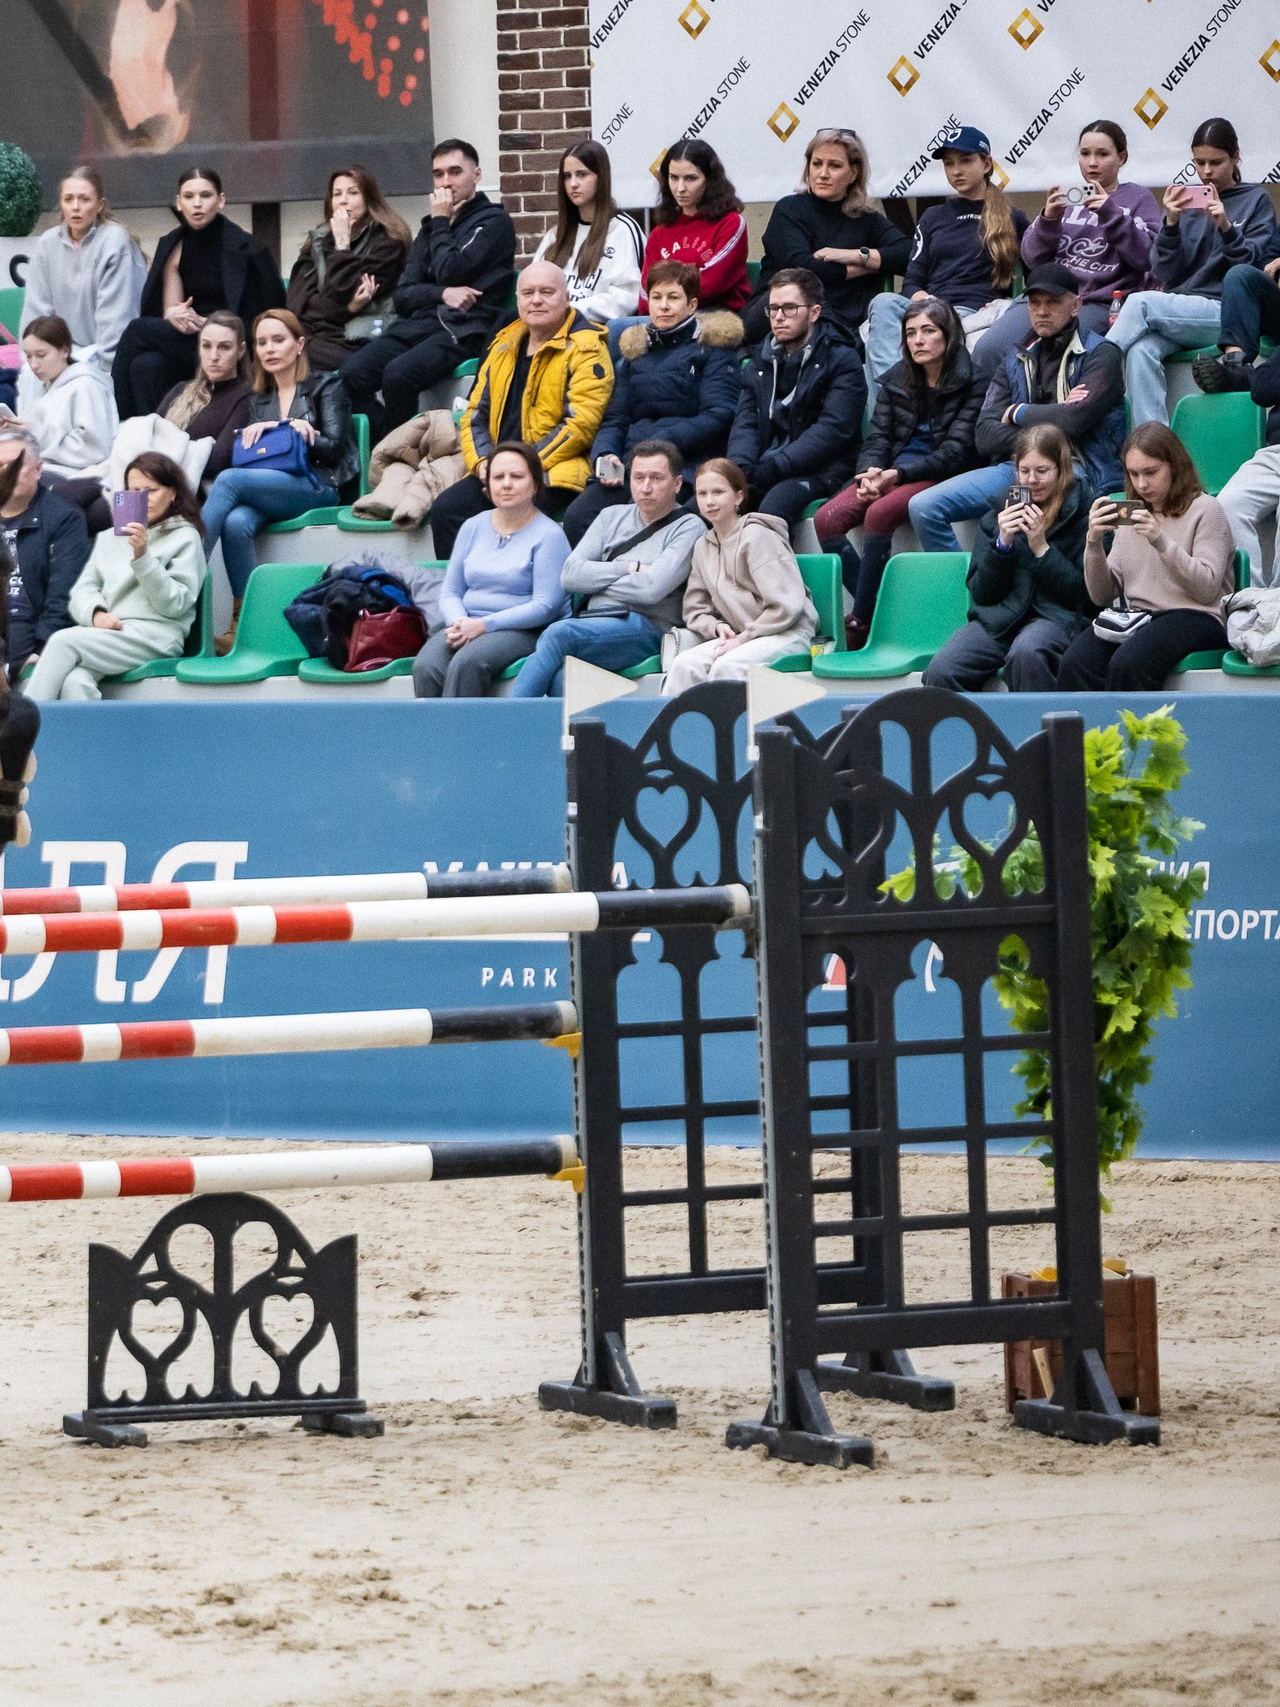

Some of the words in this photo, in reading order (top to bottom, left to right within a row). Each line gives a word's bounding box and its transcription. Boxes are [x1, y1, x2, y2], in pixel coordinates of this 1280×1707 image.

[793, 49, 840, 106] VENEZIA
[835, 9, 870, 53] STONE
[914, 2, 961, 60] VENEZIA
[1161, 34, 1211, 92] VENEZIA
[601, 102, 634, 145] STONE
[681, 96, 721, 140] ENEZIA
[716, 56, 751, 99] STONE
[1004, 108, 1053, 165] VENEZIA
[1048, 67, 1086, 111] STONE
[887, 154, 931, 198] ENEZIA
[1186, 909, 1280, 940] ПОРТ
[481, 967, 558, 988] PARK
